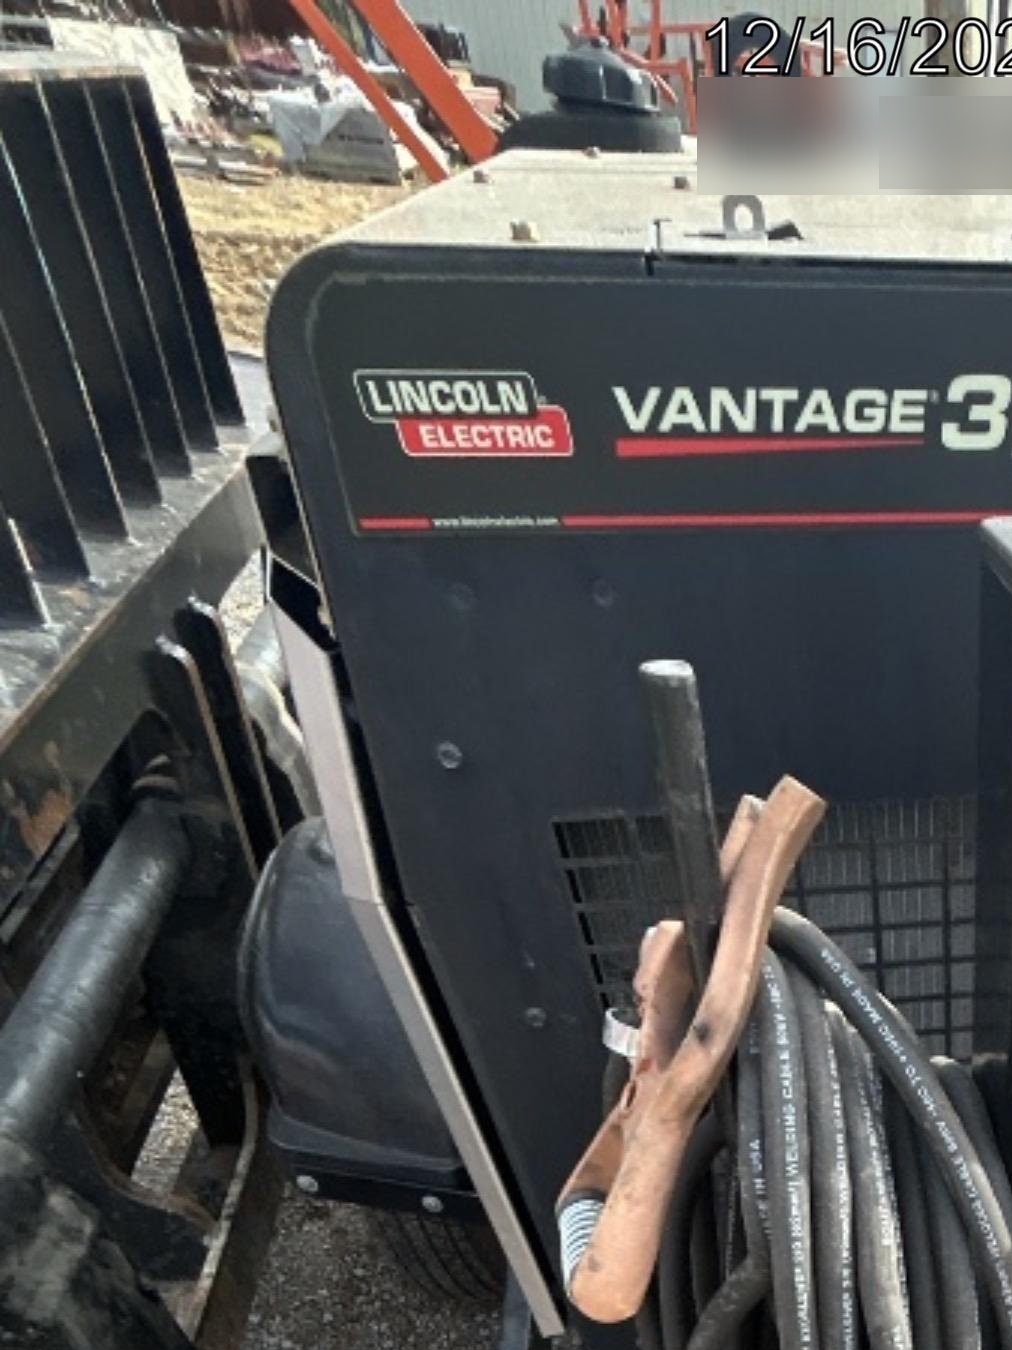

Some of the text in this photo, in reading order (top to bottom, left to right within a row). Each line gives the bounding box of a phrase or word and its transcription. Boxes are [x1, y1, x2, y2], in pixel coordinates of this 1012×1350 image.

[366, 380, 530, 414] LINCOLN
[611, 386, 929, 433] VANTAGE
[418, 424, 555, 449] ELECTRIC
[782, 1103, 800, 1178] WELDING
